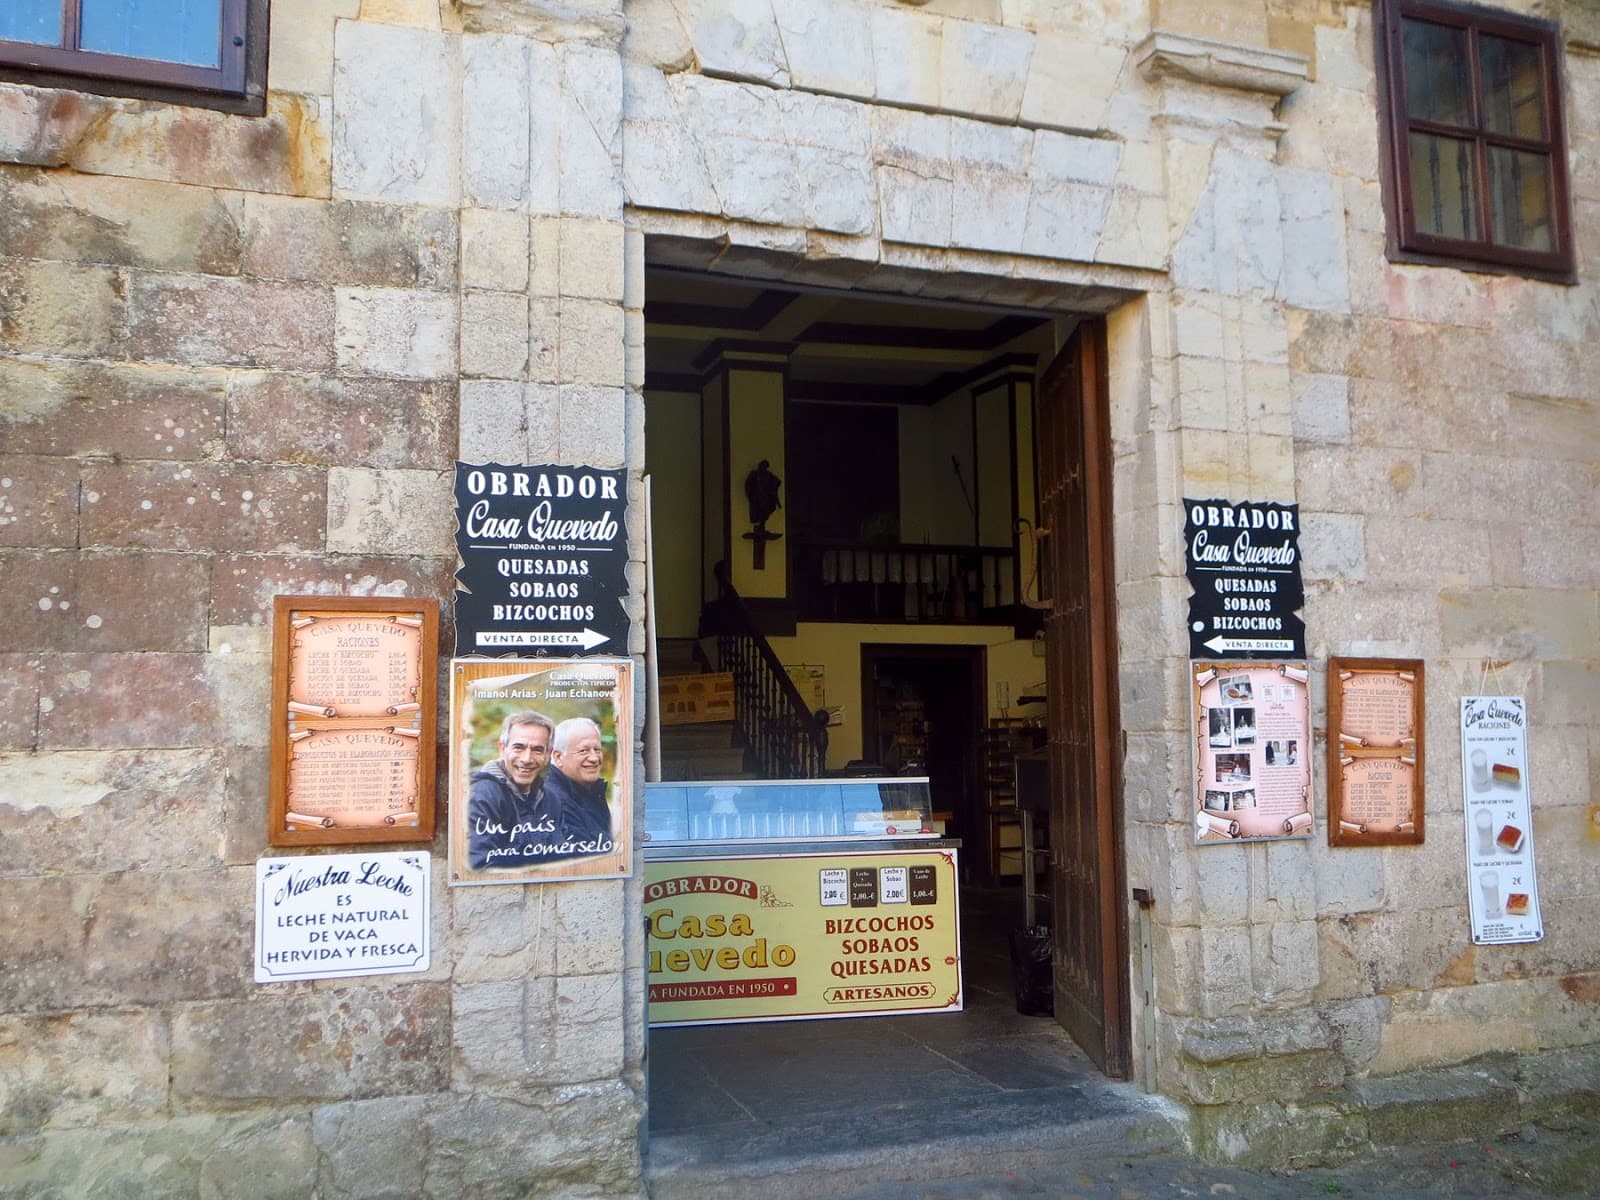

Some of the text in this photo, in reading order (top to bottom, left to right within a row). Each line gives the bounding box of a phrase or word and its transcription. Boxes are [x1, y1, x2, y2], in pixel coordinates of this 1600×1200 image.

[467, 471, 618, 499] OBRADOR
[466, 500, 618, 542] Casa Quevedo
[1191, 505, 1294, 530] OBRADOR
[1192, 529, 1295, 565] Casa Quevedo
[497, 558, 589, 577] QUESADAS
[509, 582, 579, 598] SOBAOS
[1215, 578, 1277, 593] QUESADAS
[492, 604, 594, 620] BIZCOCHOS
[1224, 597, 1271, 612] SOBAOS
[348, 622, 406, 637] QUEVEDO
[1213, 616, 1282, 630] BIZCOCHOS
[484, 634, 579, 643] VENTA DIRECTA
[1256, 641, 1289, 649] DIRECTA
[474, 689, 508, 698] Imanol
[510, 689, 537, 698] Arias
[545, 689, 567, 700] Juan
[570, 689, 616, 698] Echanove
[346, 734, 405, 747] QUEVEDO
[475, 814, 556, 842] Un país
[486, 845, 520, 863] para
[274, 861, 413, 907] Nuestra Leche
[649, 877, 751, 899] OBRADOR
[337, 894, 352, 906] ES
[278, 909, 409, 928] LECHE NATURAL
[650, 908, 754, 940] Casa
[825, 915, 934, 934] BIZCOCHOS
[309, 928, 378, 943] DE VACA
[267, 943, 418, 963] HERVIDA Y FRESCA
[841, 936, 920, 954] SOBAOS
[648, 937, 796, 973] evedo
[830, 956, 931, 979] QUESADAS
[661, 985, 725, 998] FUNDADA
[729, 984, 745, 994] EN
[749, 983, 775, 993] 1950
[832, 984, 929, 1002] ARTESANOS
